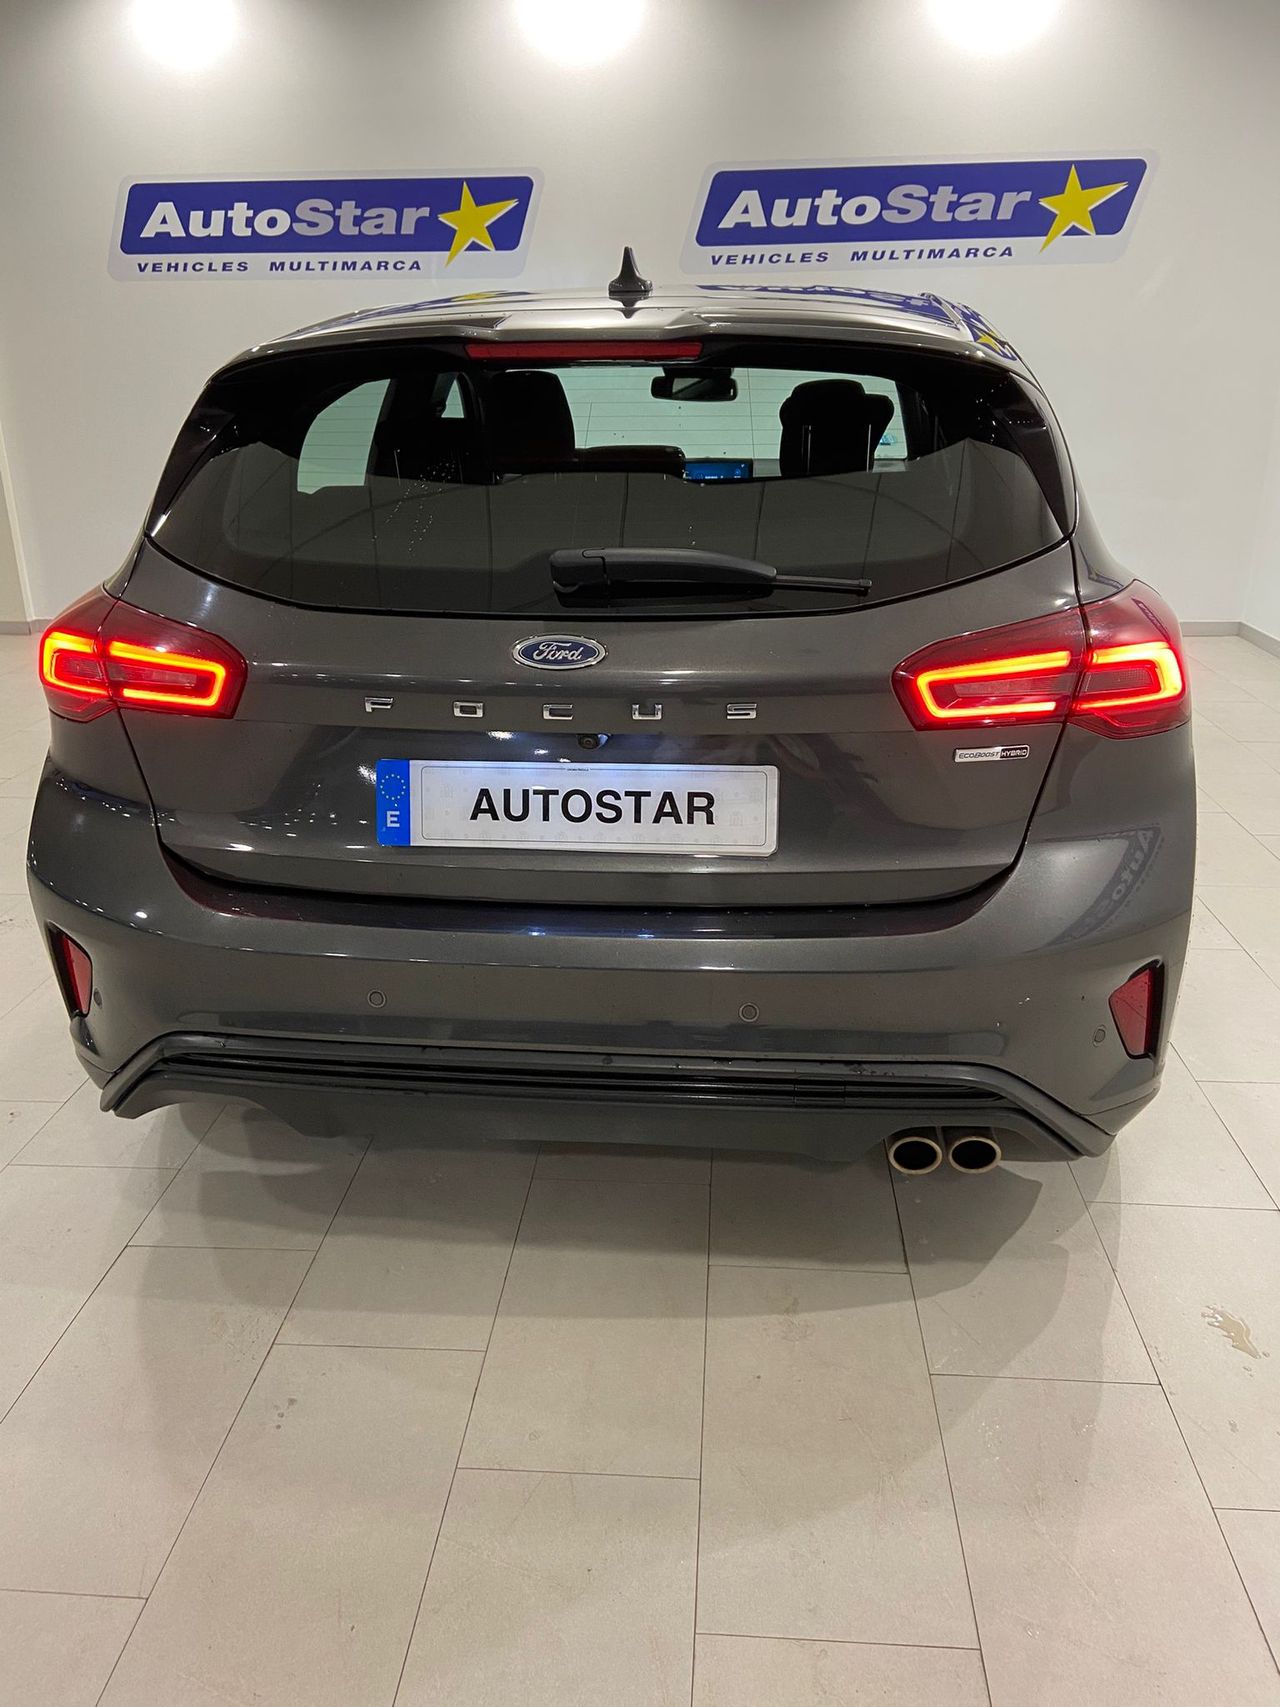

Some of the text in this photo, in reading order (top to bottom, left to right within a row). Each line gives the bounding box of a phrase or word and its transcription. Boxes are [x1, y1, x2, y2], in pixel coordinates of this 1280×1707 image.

[717, 184, 1032, 229] AutoStar
[139, 199, 430, 238] AutoStar
[137, 260, 422, 273] VEHICLES MULTIMARCA
[711, 246, 1014, 266] VEHICLES MULTIMARCA
[533, 641, 583, 660] Ford
[364, 696, 757, 720] FOCUS
[469, 787, 716, 825] AUTOSTAR
[386, 810, 400, 828] E
